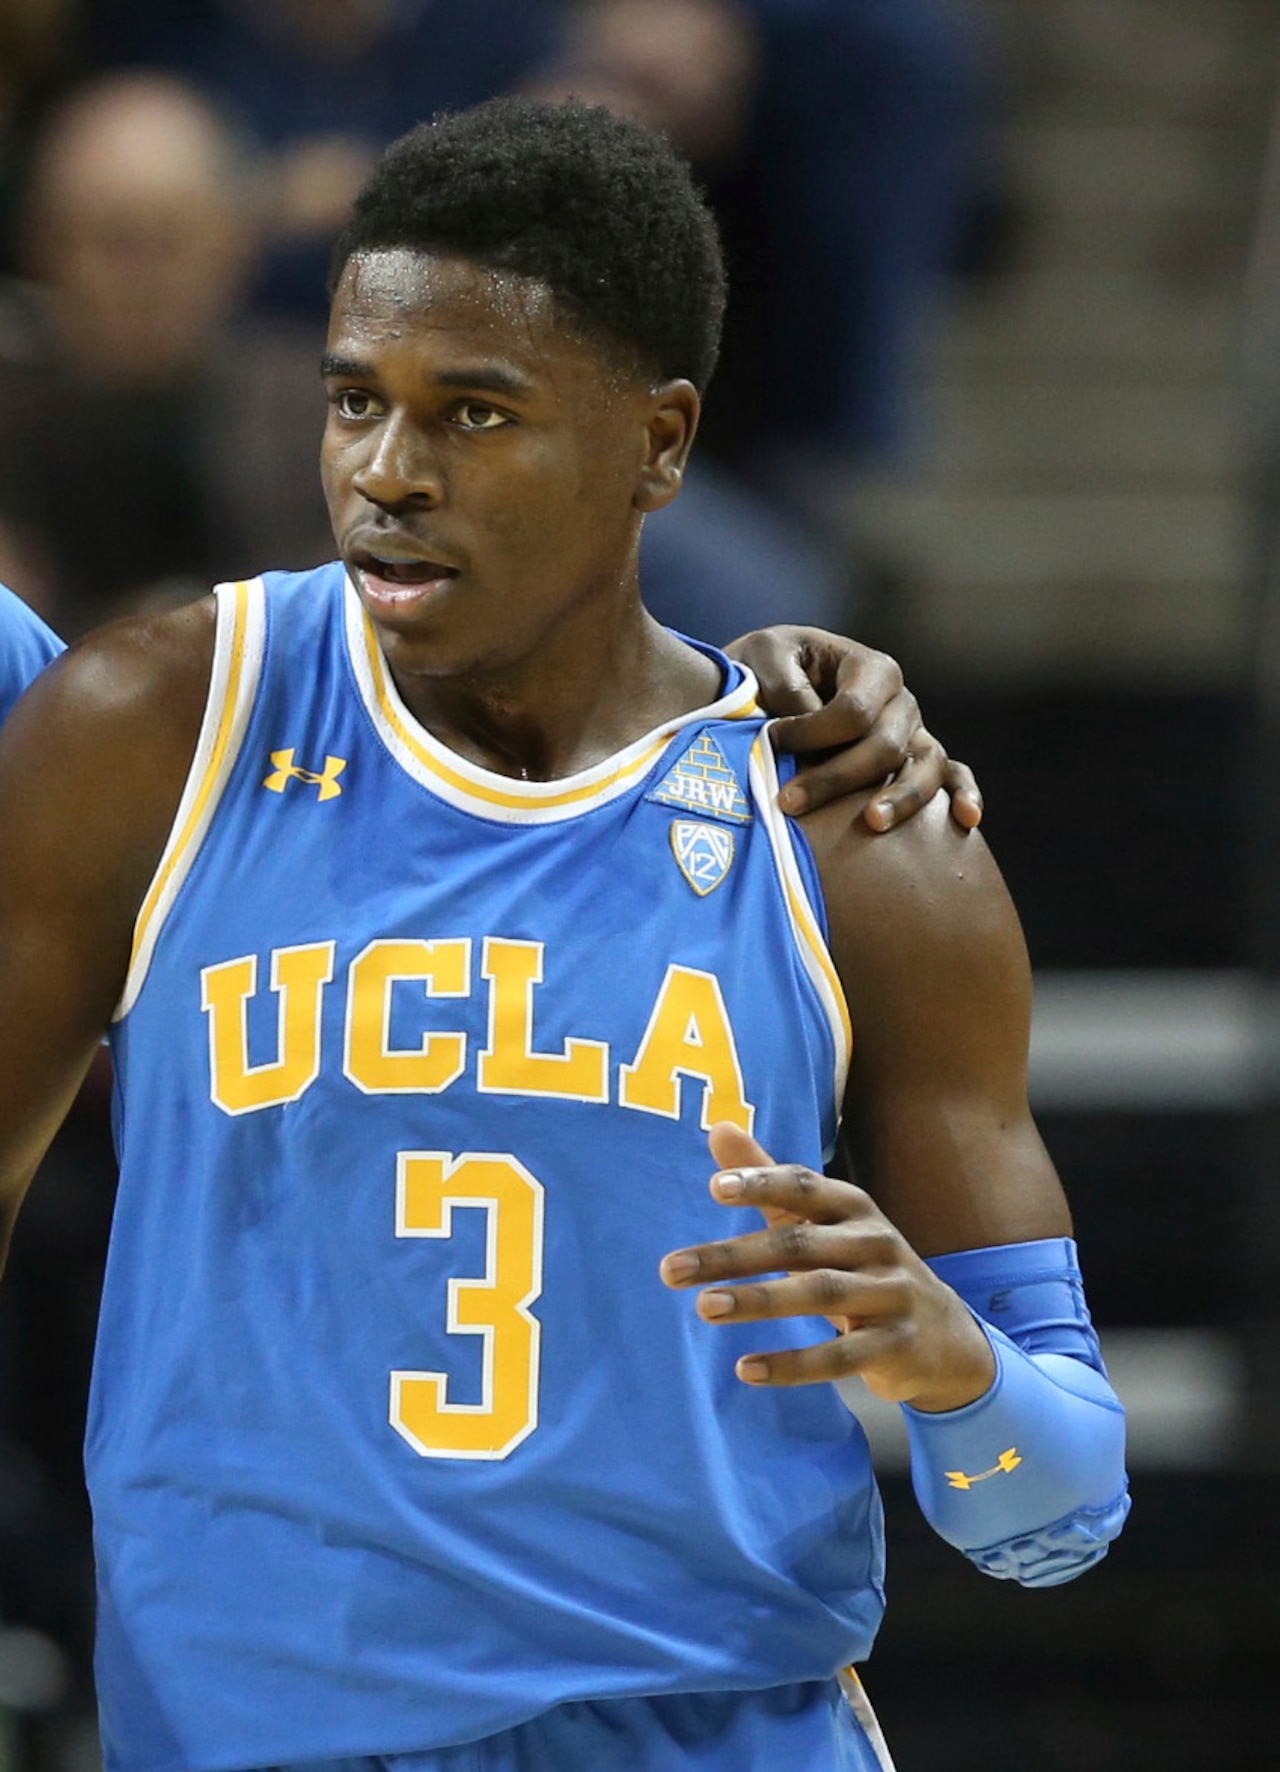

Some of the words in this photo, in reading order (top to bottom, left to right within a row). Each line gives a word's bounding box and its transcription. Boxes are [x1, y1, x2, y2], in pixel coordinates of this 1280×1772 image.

[669, 774, 738, 812] JRW
[676, 824, 729, 871] PAC
[690, 851, 717, 880] 12
[201, 936, 756, 1136] UCLA
[389, 1151, 545, 1460] 3
